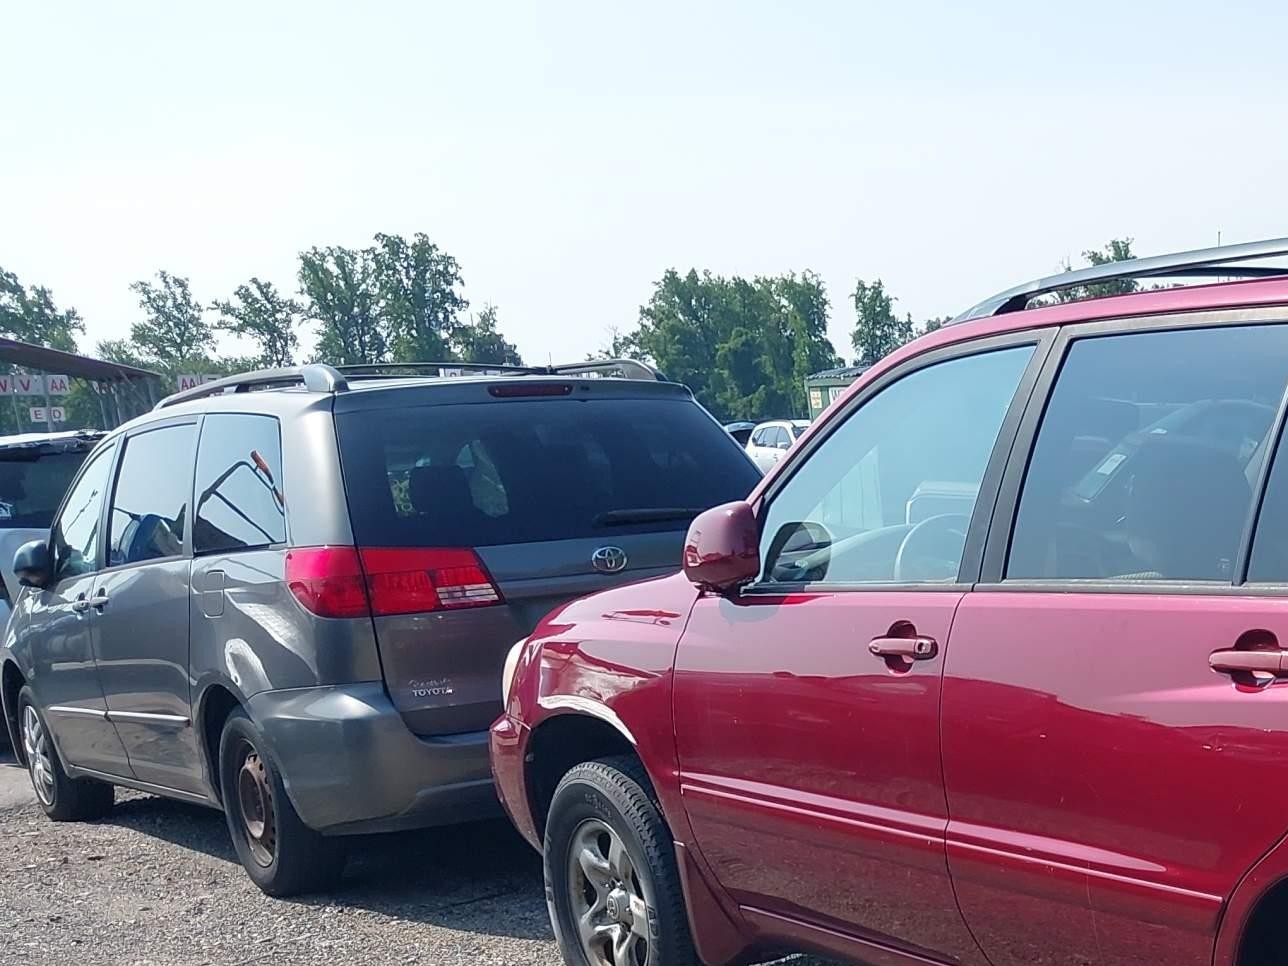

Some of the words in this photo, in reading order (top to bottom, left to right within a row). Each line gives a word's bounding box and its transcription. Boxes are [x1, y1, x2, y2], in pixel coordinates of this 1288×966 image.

[19, 379, 31, 392] V
[50, 379, 67, 391] AA
[33, 409, 44, 420] E
[412, 687, 455, 697] TOYOTA
